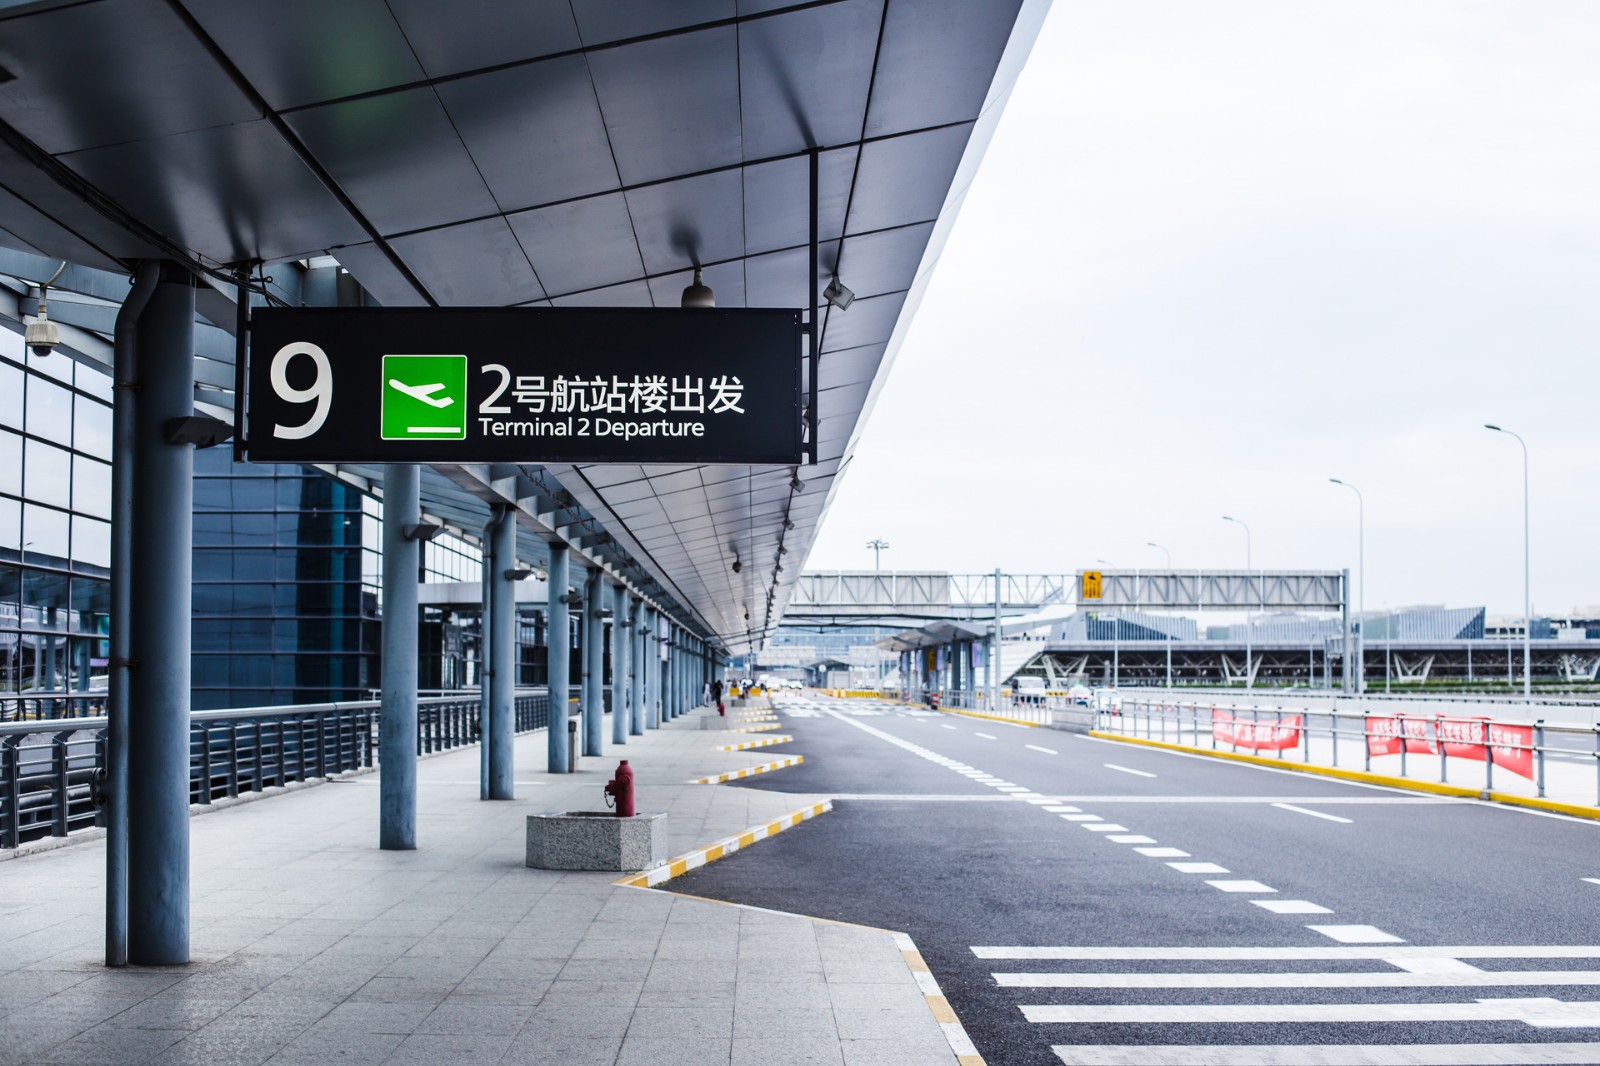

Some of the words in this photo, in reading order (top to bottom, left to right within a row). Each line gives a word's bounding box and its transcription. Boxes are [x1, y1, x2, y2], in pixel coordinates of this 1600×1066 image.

[270, 341, 334, 440] 9
[478, 363, 746, 415] 2号航站楼出发
[478, 416, 573, 437] Terminal
[577, 417, 590, 436] 2
[595, 417, 705, 441] Departure
